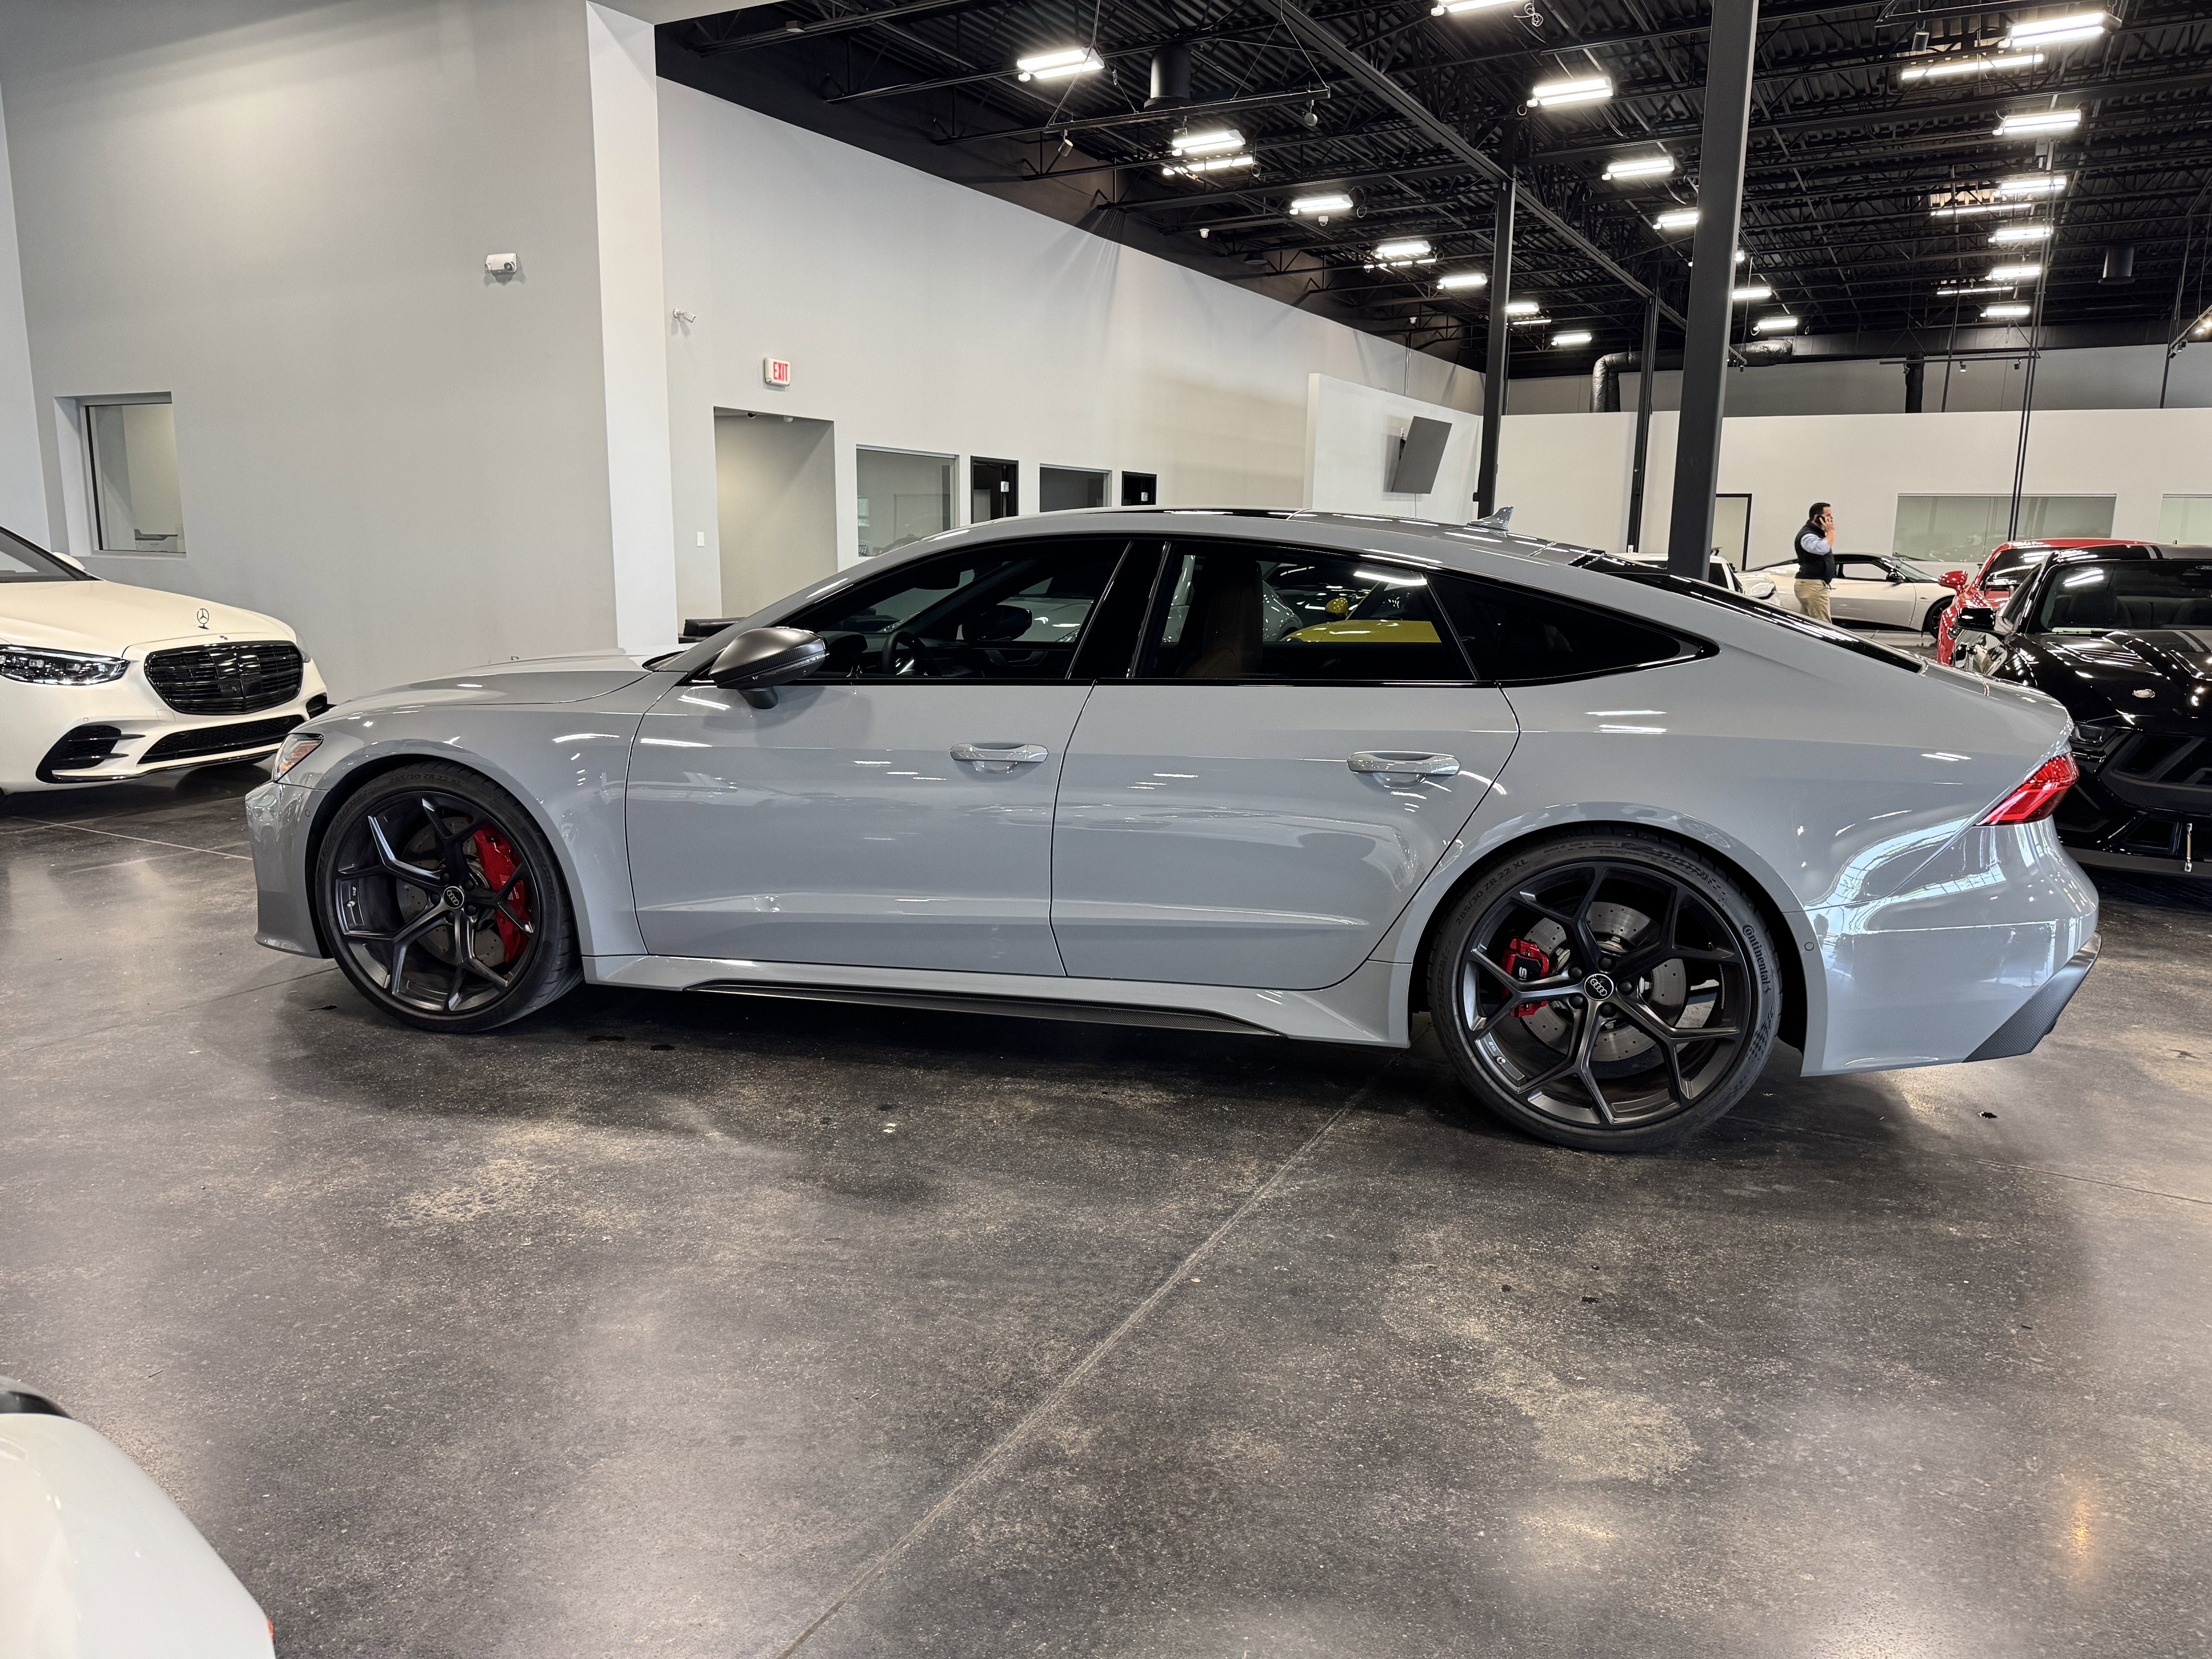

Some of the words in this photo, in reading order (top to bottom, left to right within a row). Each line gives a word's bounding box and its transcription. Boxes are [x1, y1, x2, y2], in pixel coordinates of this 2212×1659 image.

[773, 361, 788, 381] EXIT
[1456, 890, 1483, 925] 285/30
[1484, 878, 1498, 891] ZR
[1498, 867, 1511, 879] 22
[1513, 859, 1528, 869] XL
[1519, 967, 1527, 981] S
[1742, 924, 1771, 985] Continental
